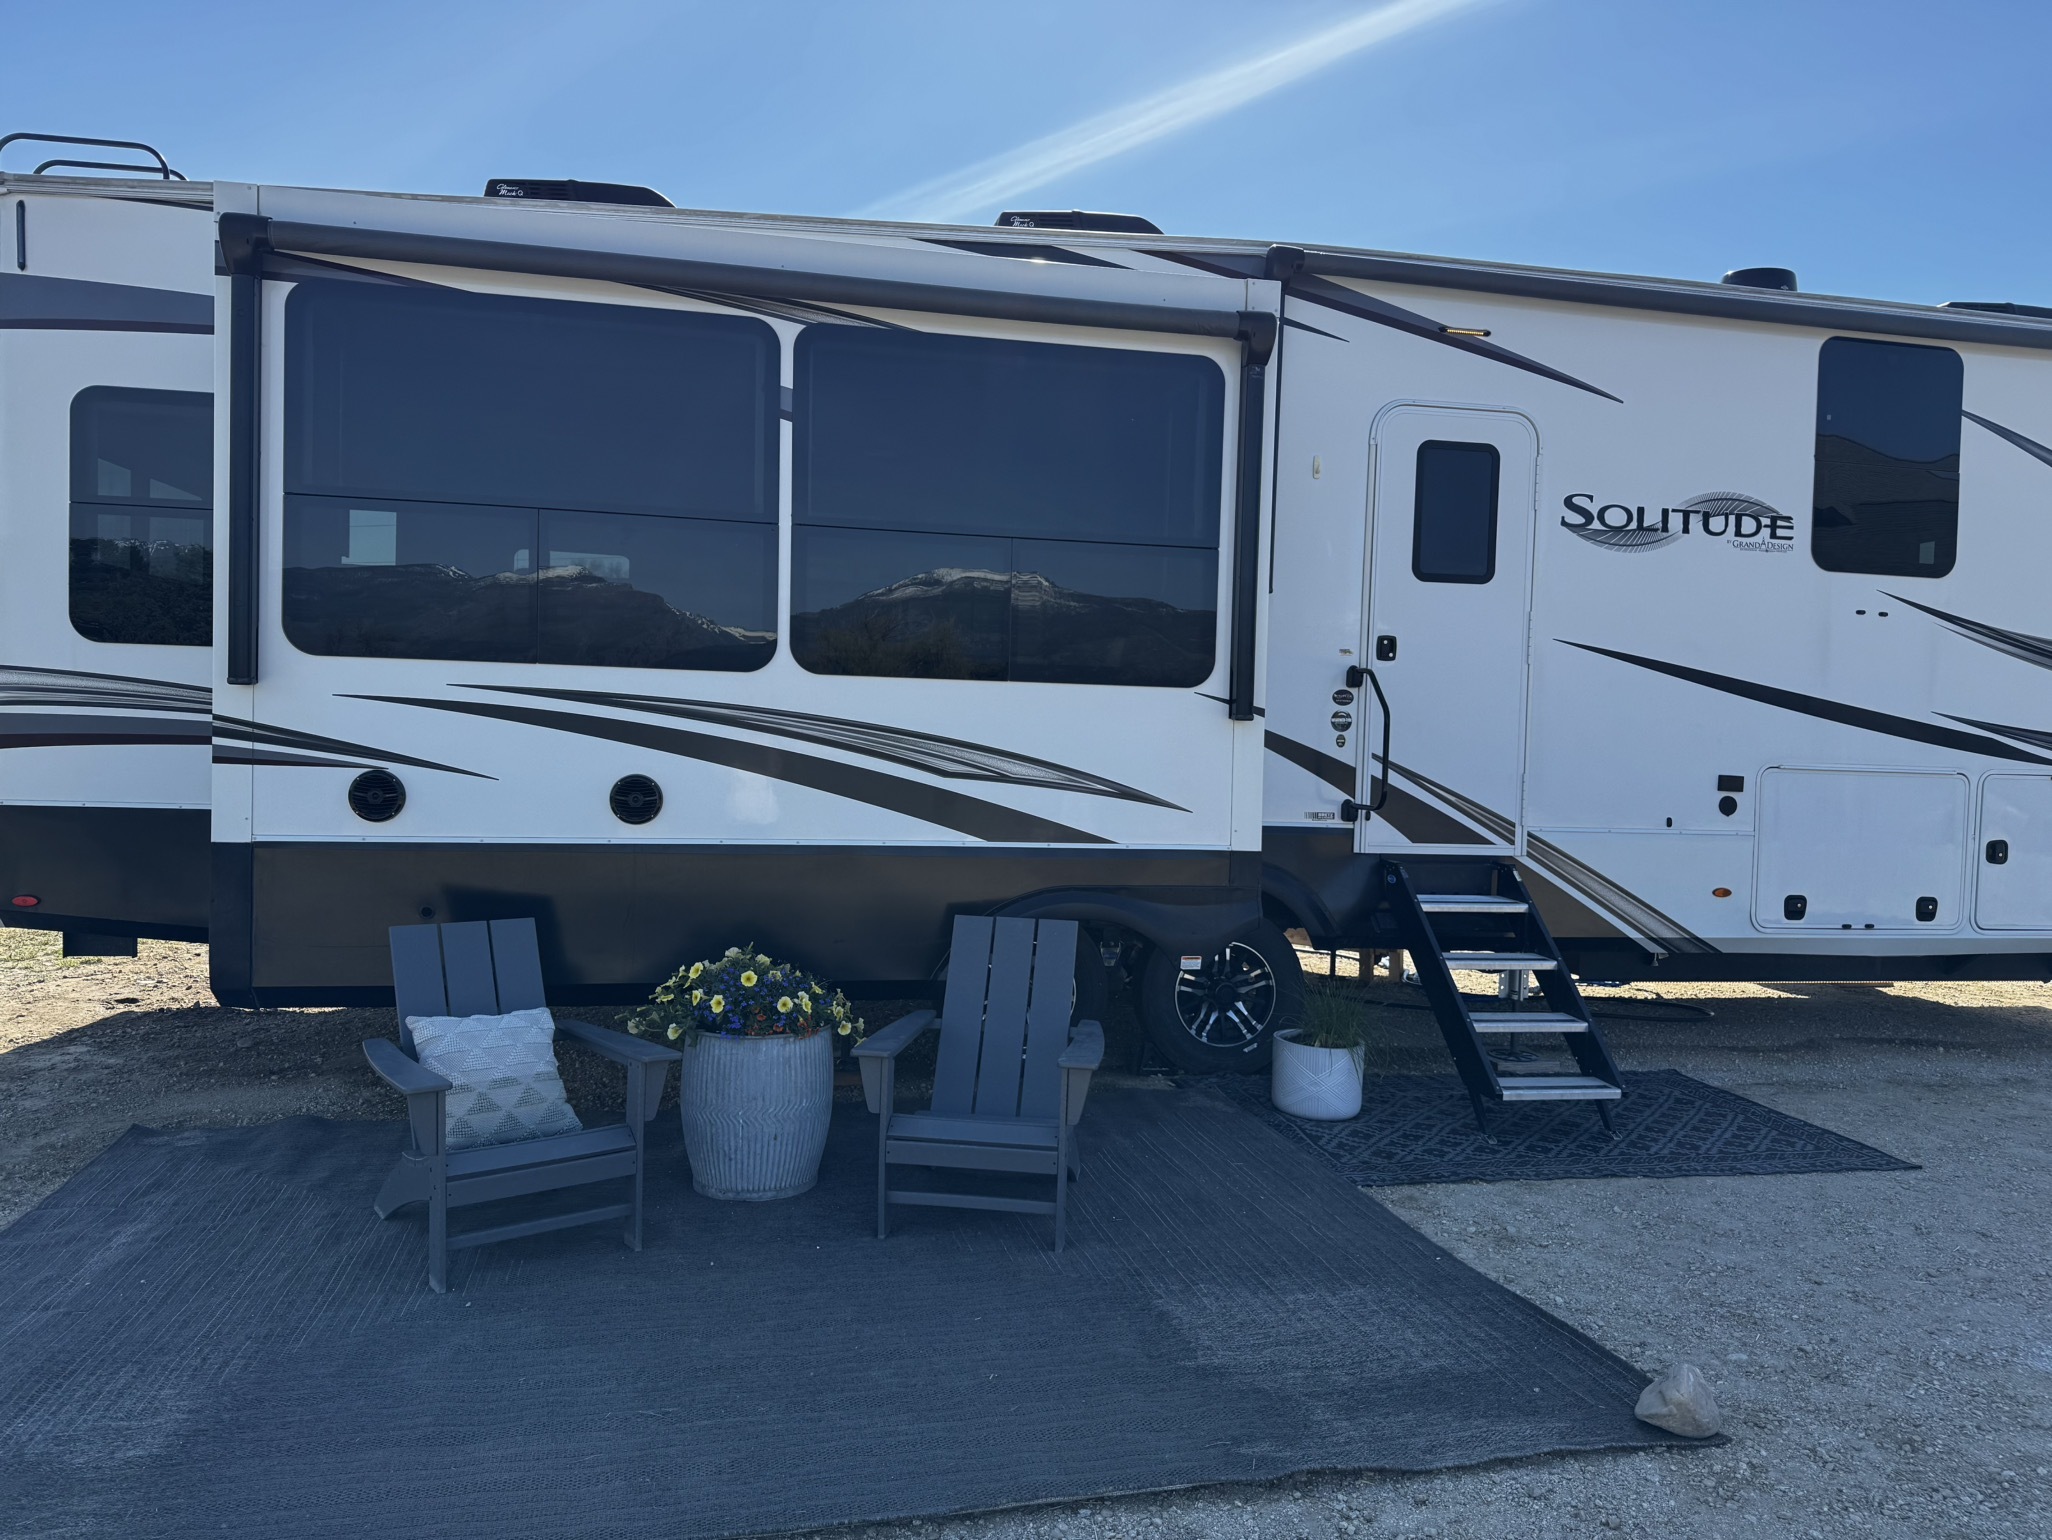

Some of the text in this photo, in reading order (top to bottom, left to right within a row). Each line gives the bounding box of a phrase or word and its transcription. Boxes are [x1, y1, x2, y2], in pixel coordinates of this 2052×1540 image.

[1560, 493, 1794, 541] SOLITUDE
[1732, 539, 1761, 550] GRAND
[1766, 541, 1794, 551] DESIGN
